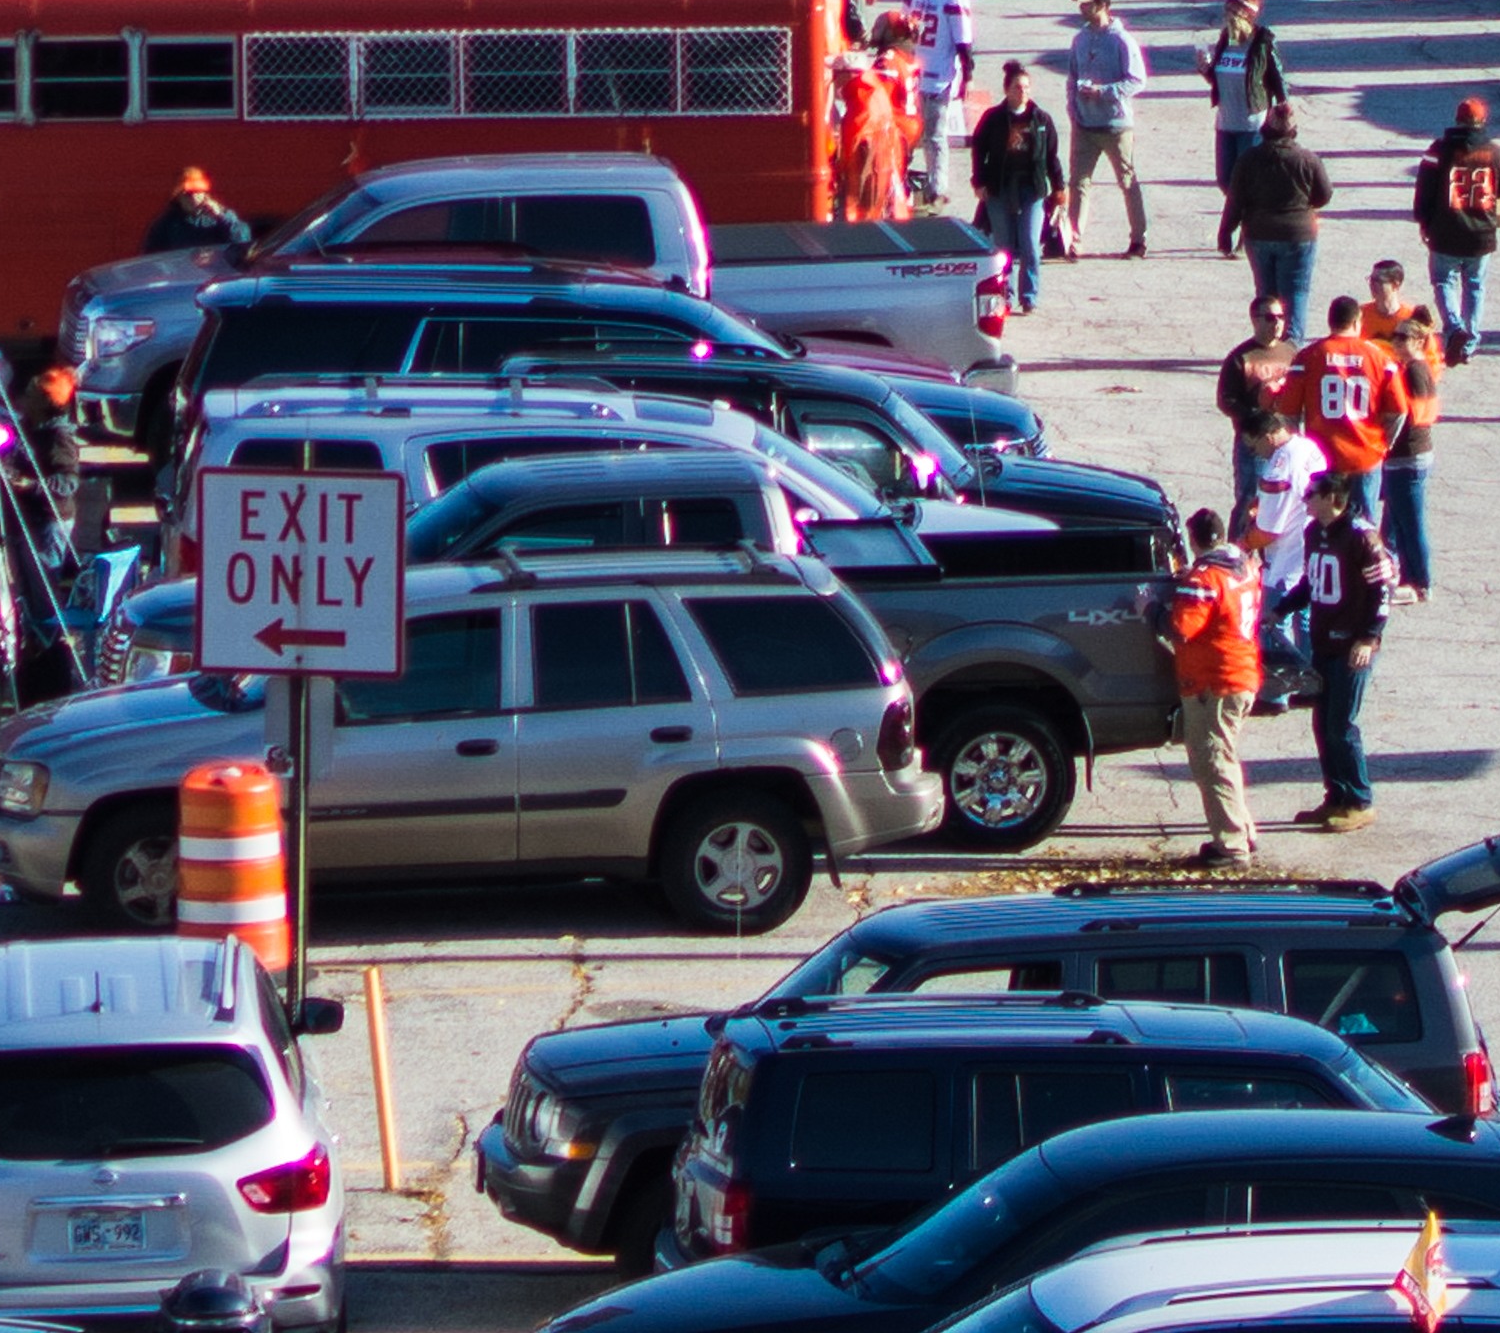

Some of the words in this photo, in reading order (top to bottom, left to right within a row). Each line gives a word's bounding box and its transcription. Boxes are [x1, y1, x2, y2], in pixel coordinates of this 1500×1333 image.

[885, 264, 936, 277] TRD
[1321, 374, 1371, 421] 80
[240, 490, 363, 545] EXIT
[226, 551, 376, 609] ONLY
